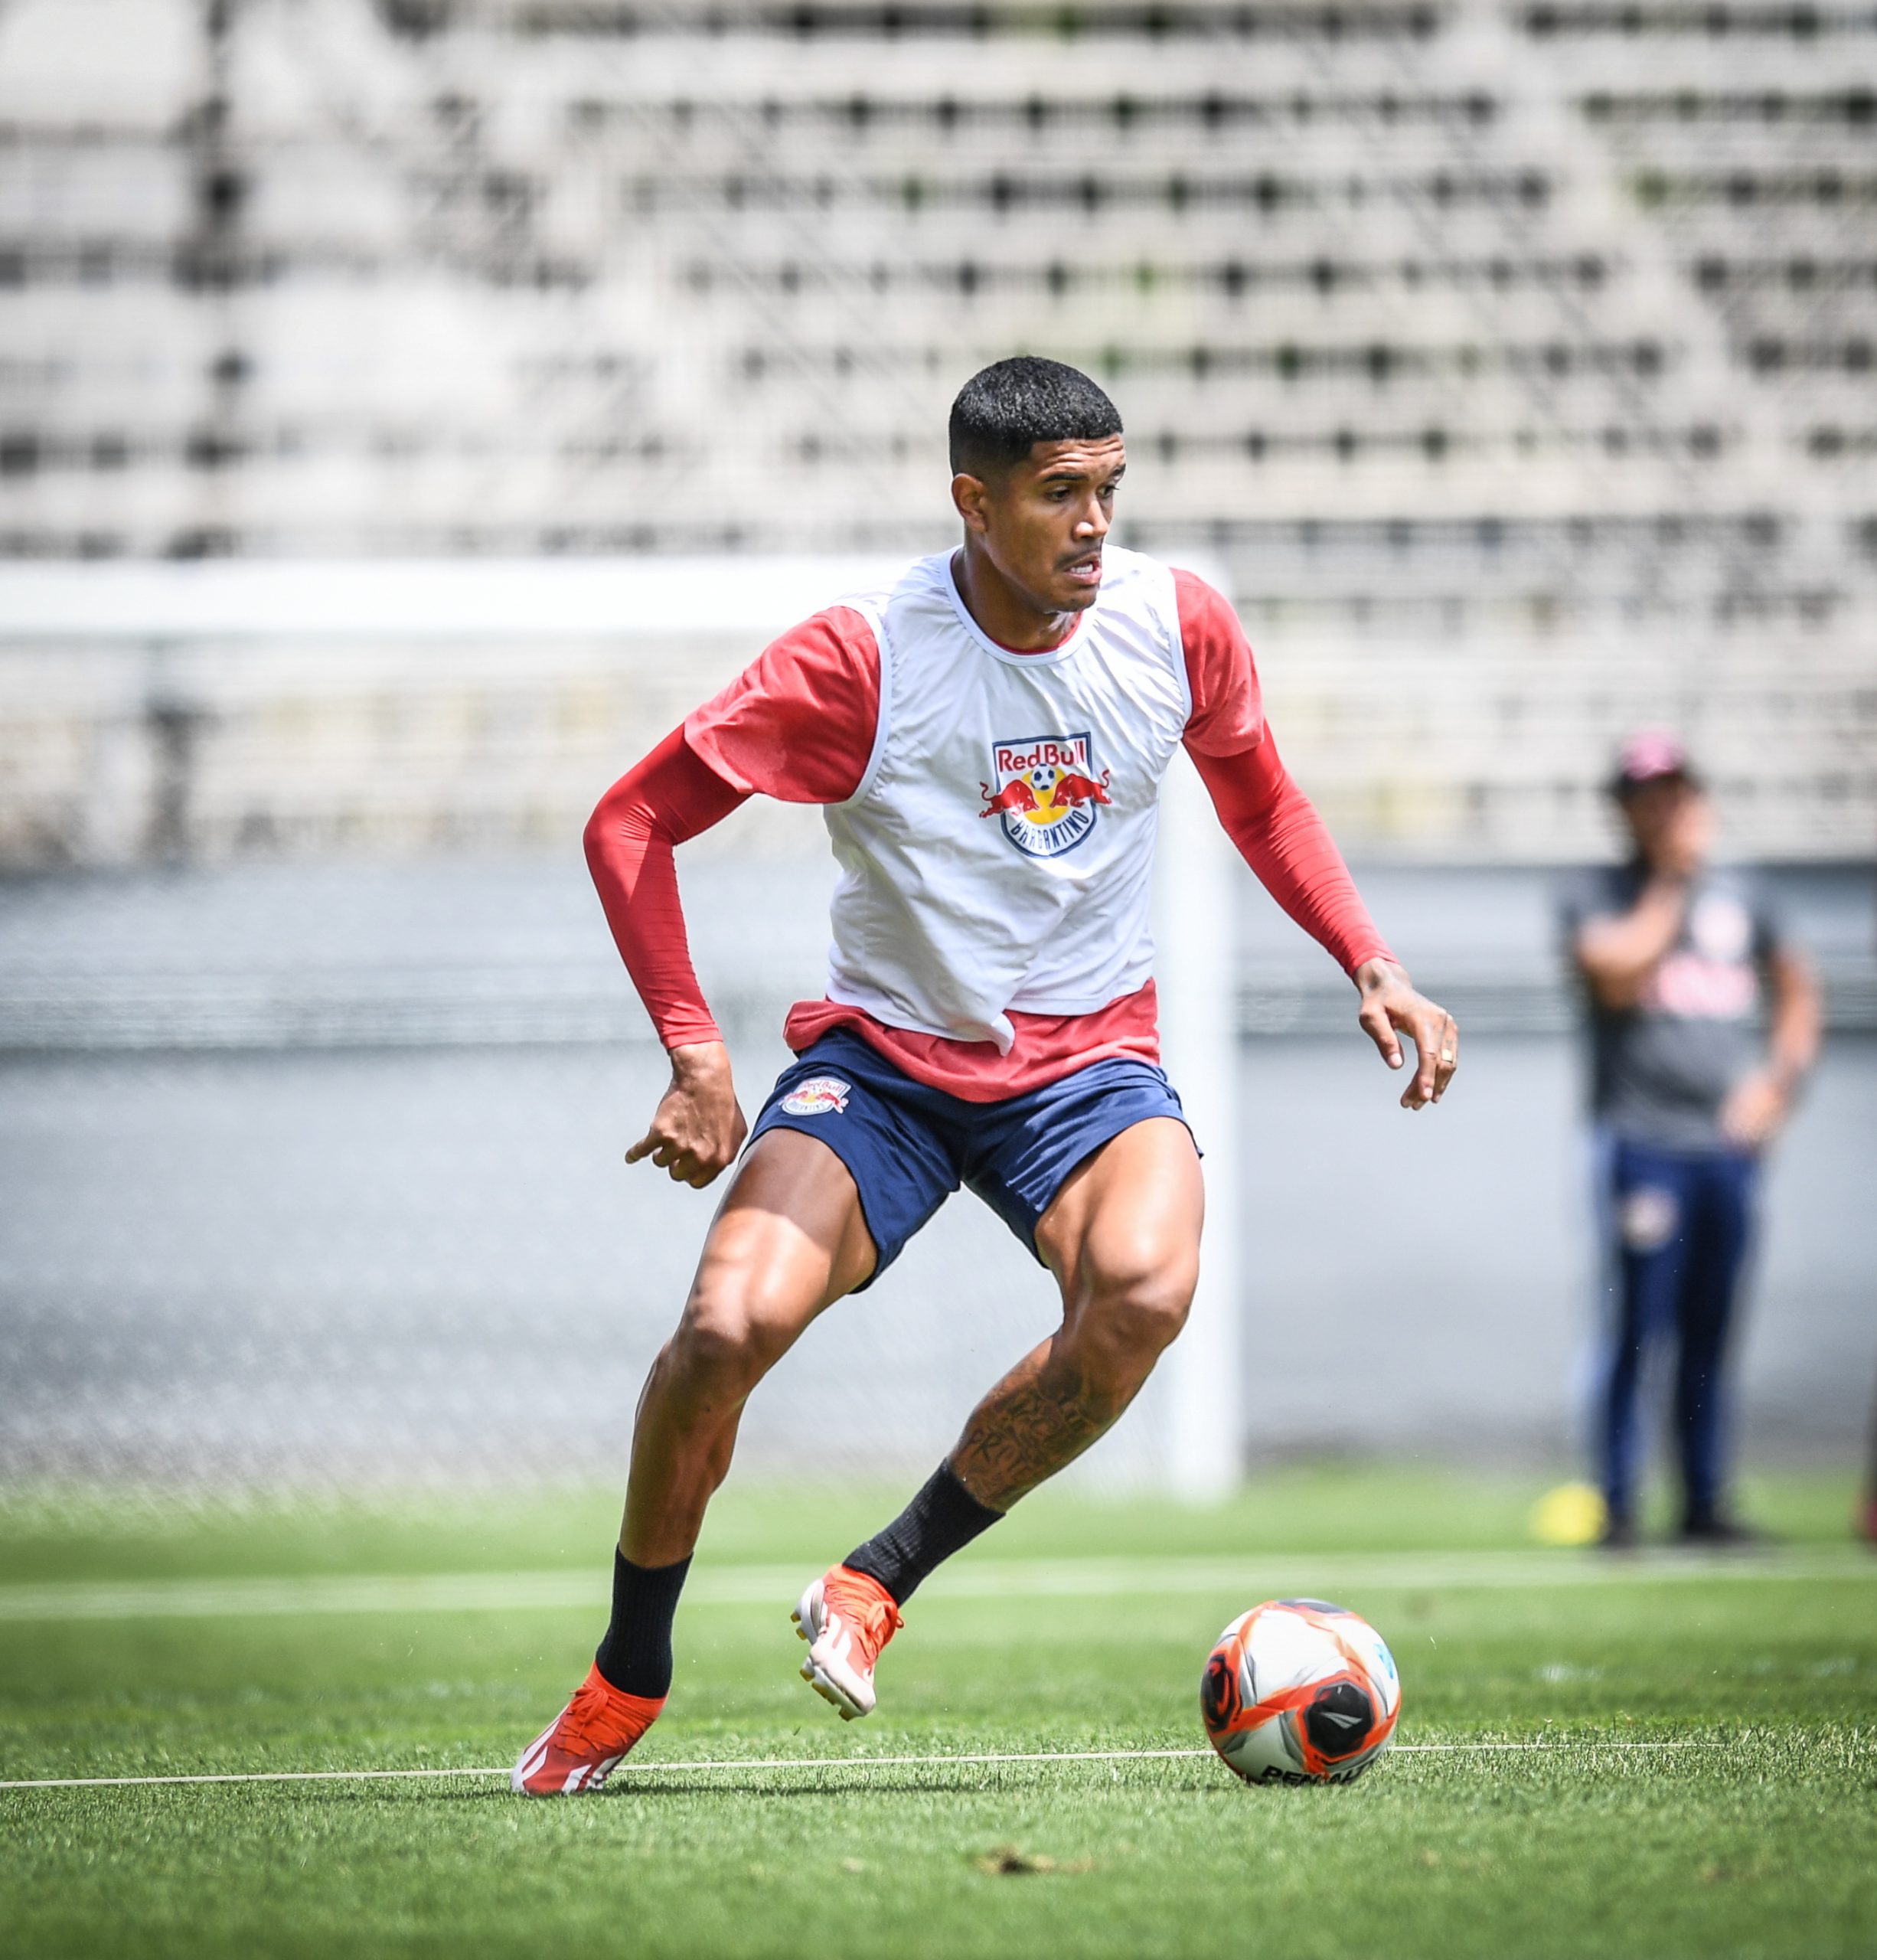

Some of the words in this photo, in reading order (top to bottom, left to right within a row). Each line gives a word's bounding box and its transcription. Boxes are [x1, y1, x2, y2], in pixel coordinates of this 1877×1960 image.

[998, 745, 1041, 772] Red
[1044, 740, 1084, 766] Bull
[1011, 810, 1089, 849] BRAGANTINO
